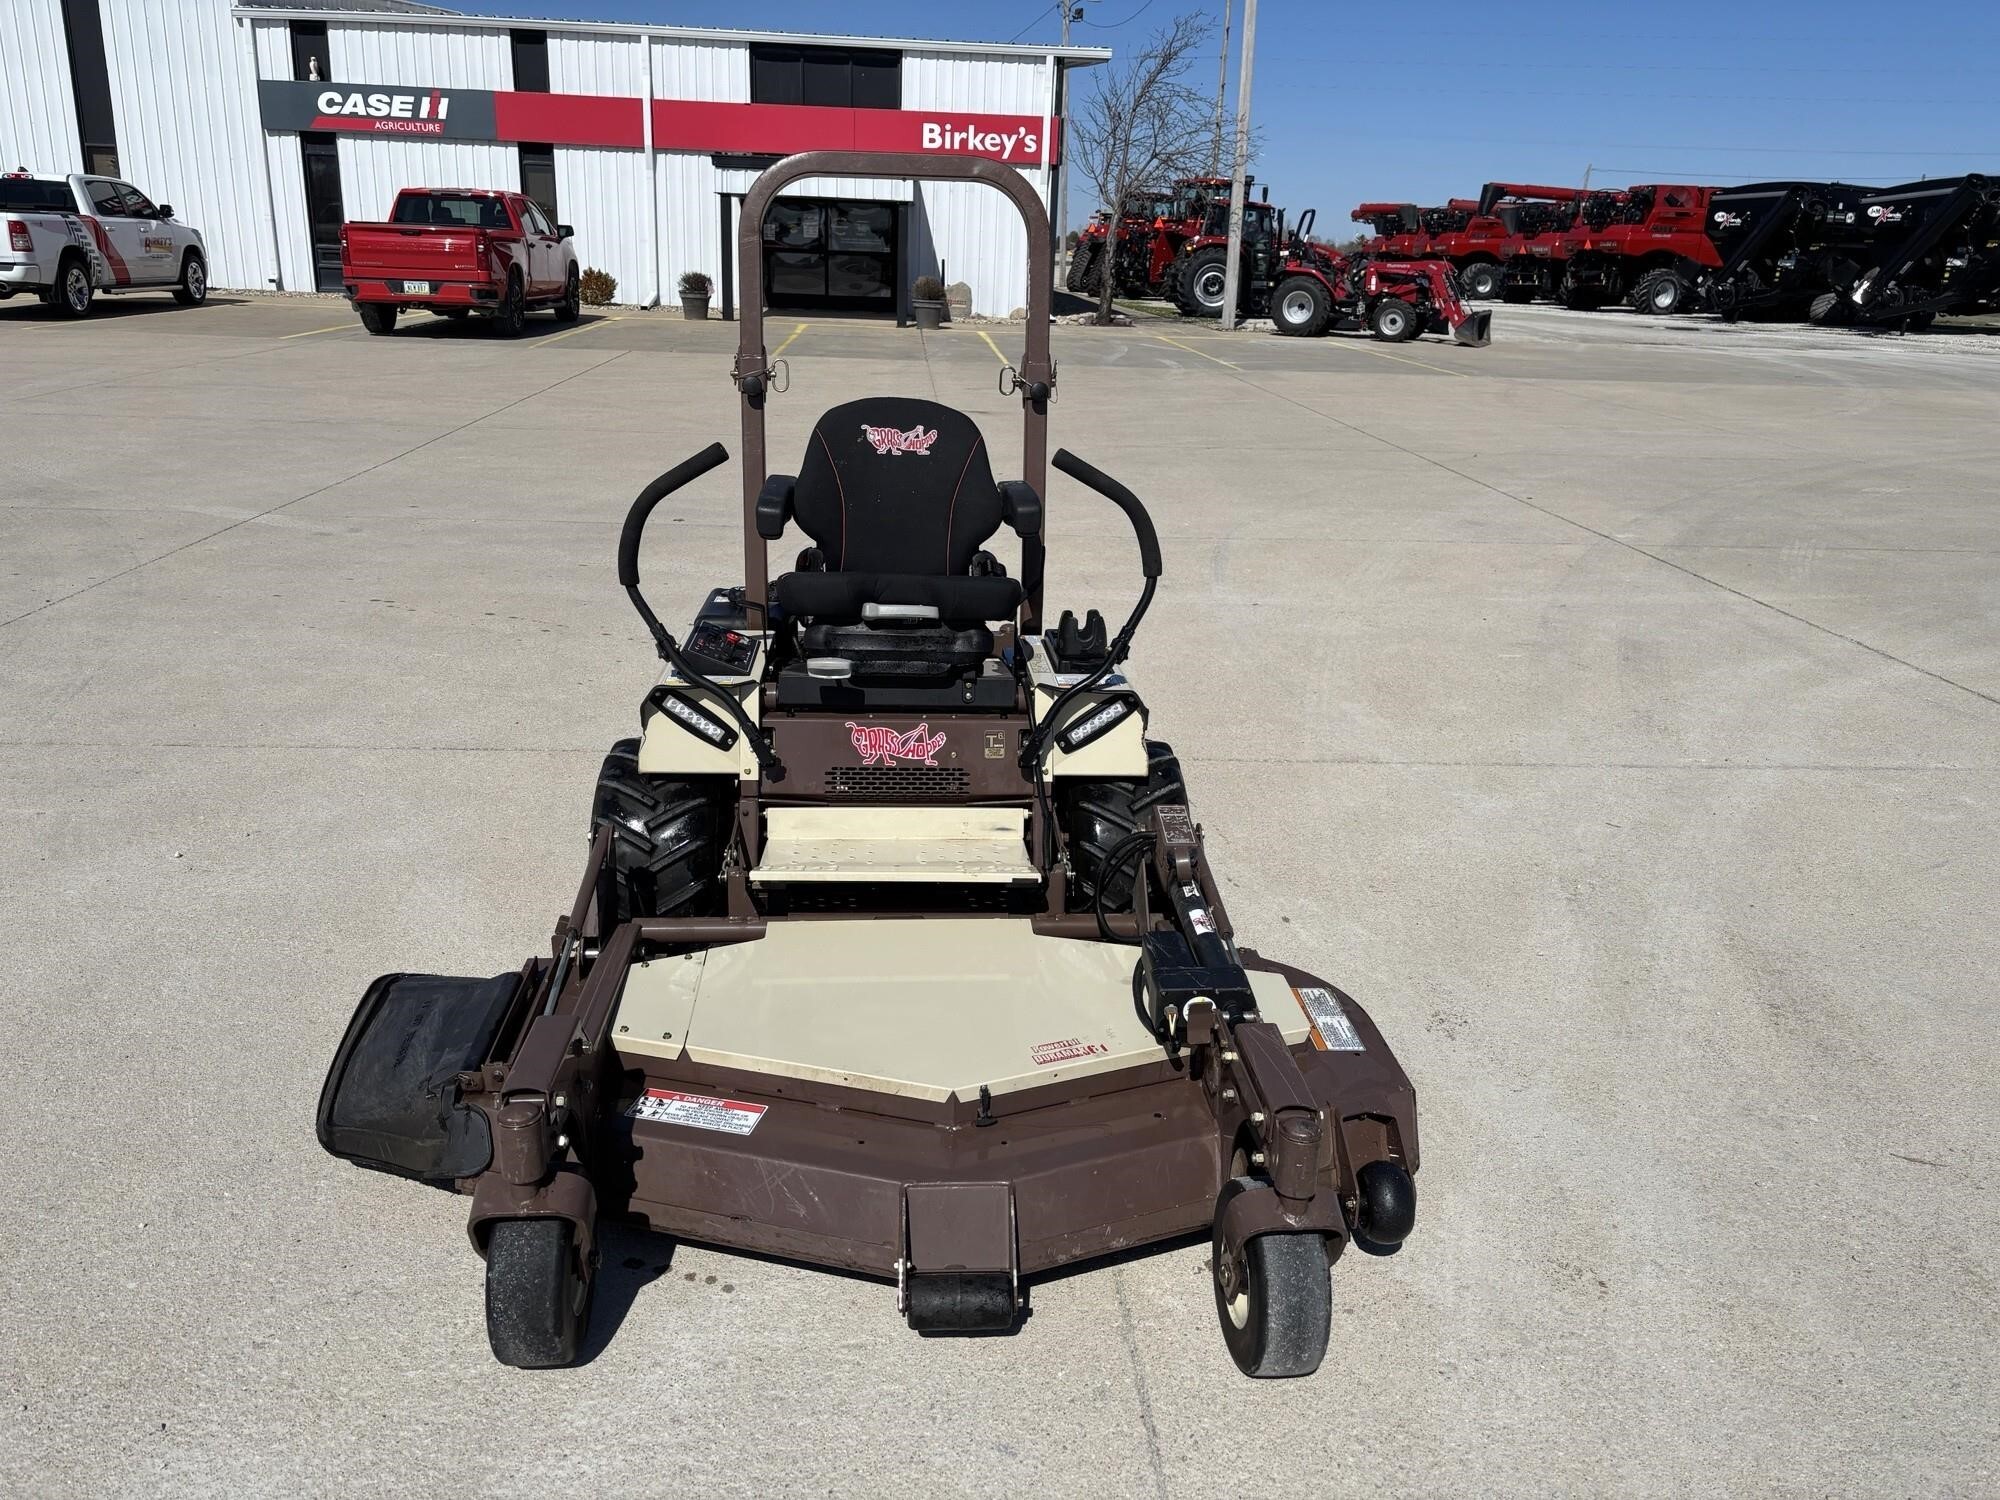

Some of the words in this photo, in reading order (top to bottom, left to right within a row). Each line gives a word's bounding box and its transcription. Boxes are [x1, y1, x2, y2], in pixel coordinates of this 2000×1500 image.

[317, 91, 415, 118] CASE
[374, 121, 441, 132] AGRICULTURE
[922, 122, 1037, 159] Birkey's
[683, 1096, 725, 1107] DANGER
